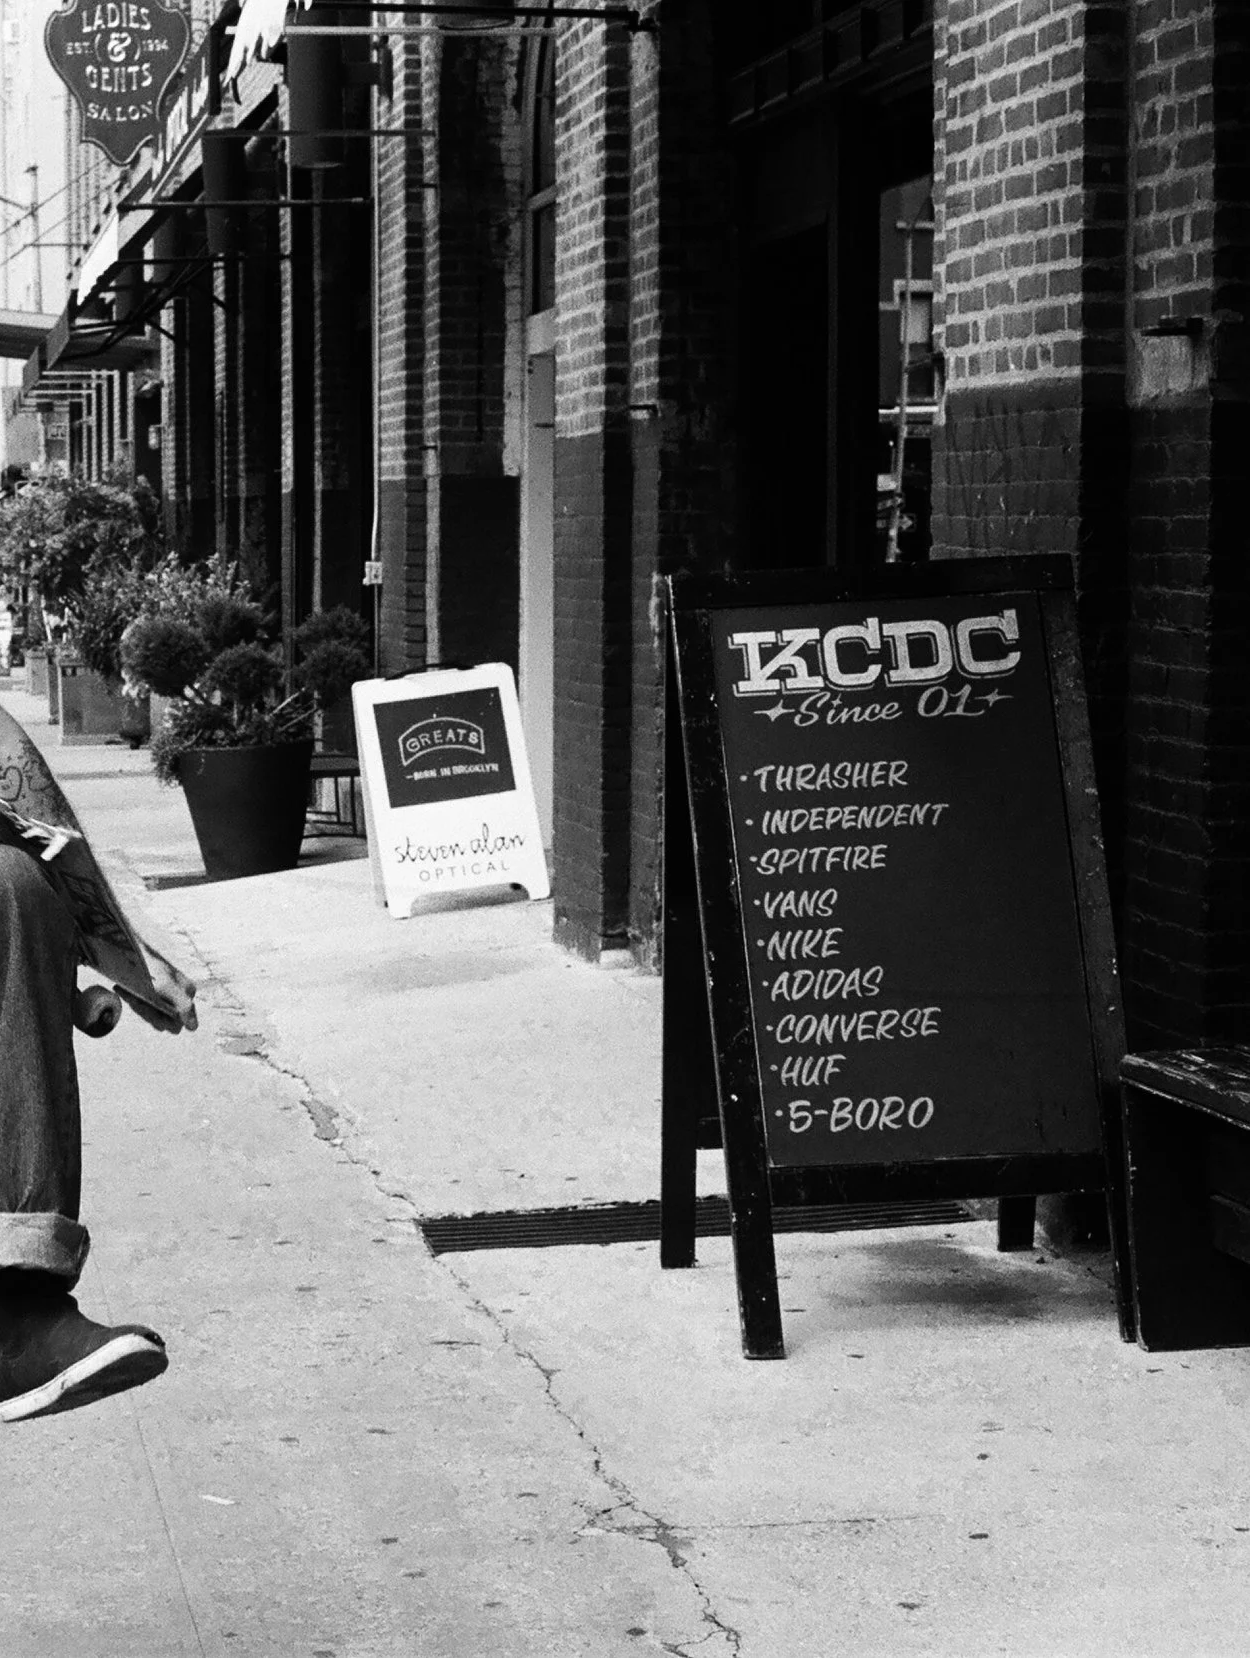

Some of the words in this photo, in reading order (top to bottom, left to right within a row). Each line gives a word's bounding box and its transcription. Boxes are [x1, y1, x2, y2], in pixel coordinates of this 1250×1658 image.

[81, 2, 152, 34] LADIES
[107, 31, 132, 63] &
[85, 63, 153, 93] GENTS
[86, 100, 153, 122] SALON
[729, 609, 1021, 696] KCDC
[794, 691, 903, 727] Since
[917, 684, 985, 717] 01
[406, 728, 478, 752] GREATS
[452, 762, 500, 775] BROOKLYN
[754, 761, 908, 792] THRASHER
[762, 803, 949, 835] INDEPENDENT
[395, 836, 465, 863] steven
[470, 822, 525, 855] alan
[419, 860, 510, 882] OPTICAL
[757, 844, 887, 875] SPITFIRE
[764, 888, 838, 918] VANS
[767, 928, 843, 960] NIKE
[771, 966, 883, 1001] ADIDAS
[776, 1007, 941, 1044] CONVERSE
[781, 1054, 846, 1086] HUF
[788, 1096, 934, 1133] 5-BORO
